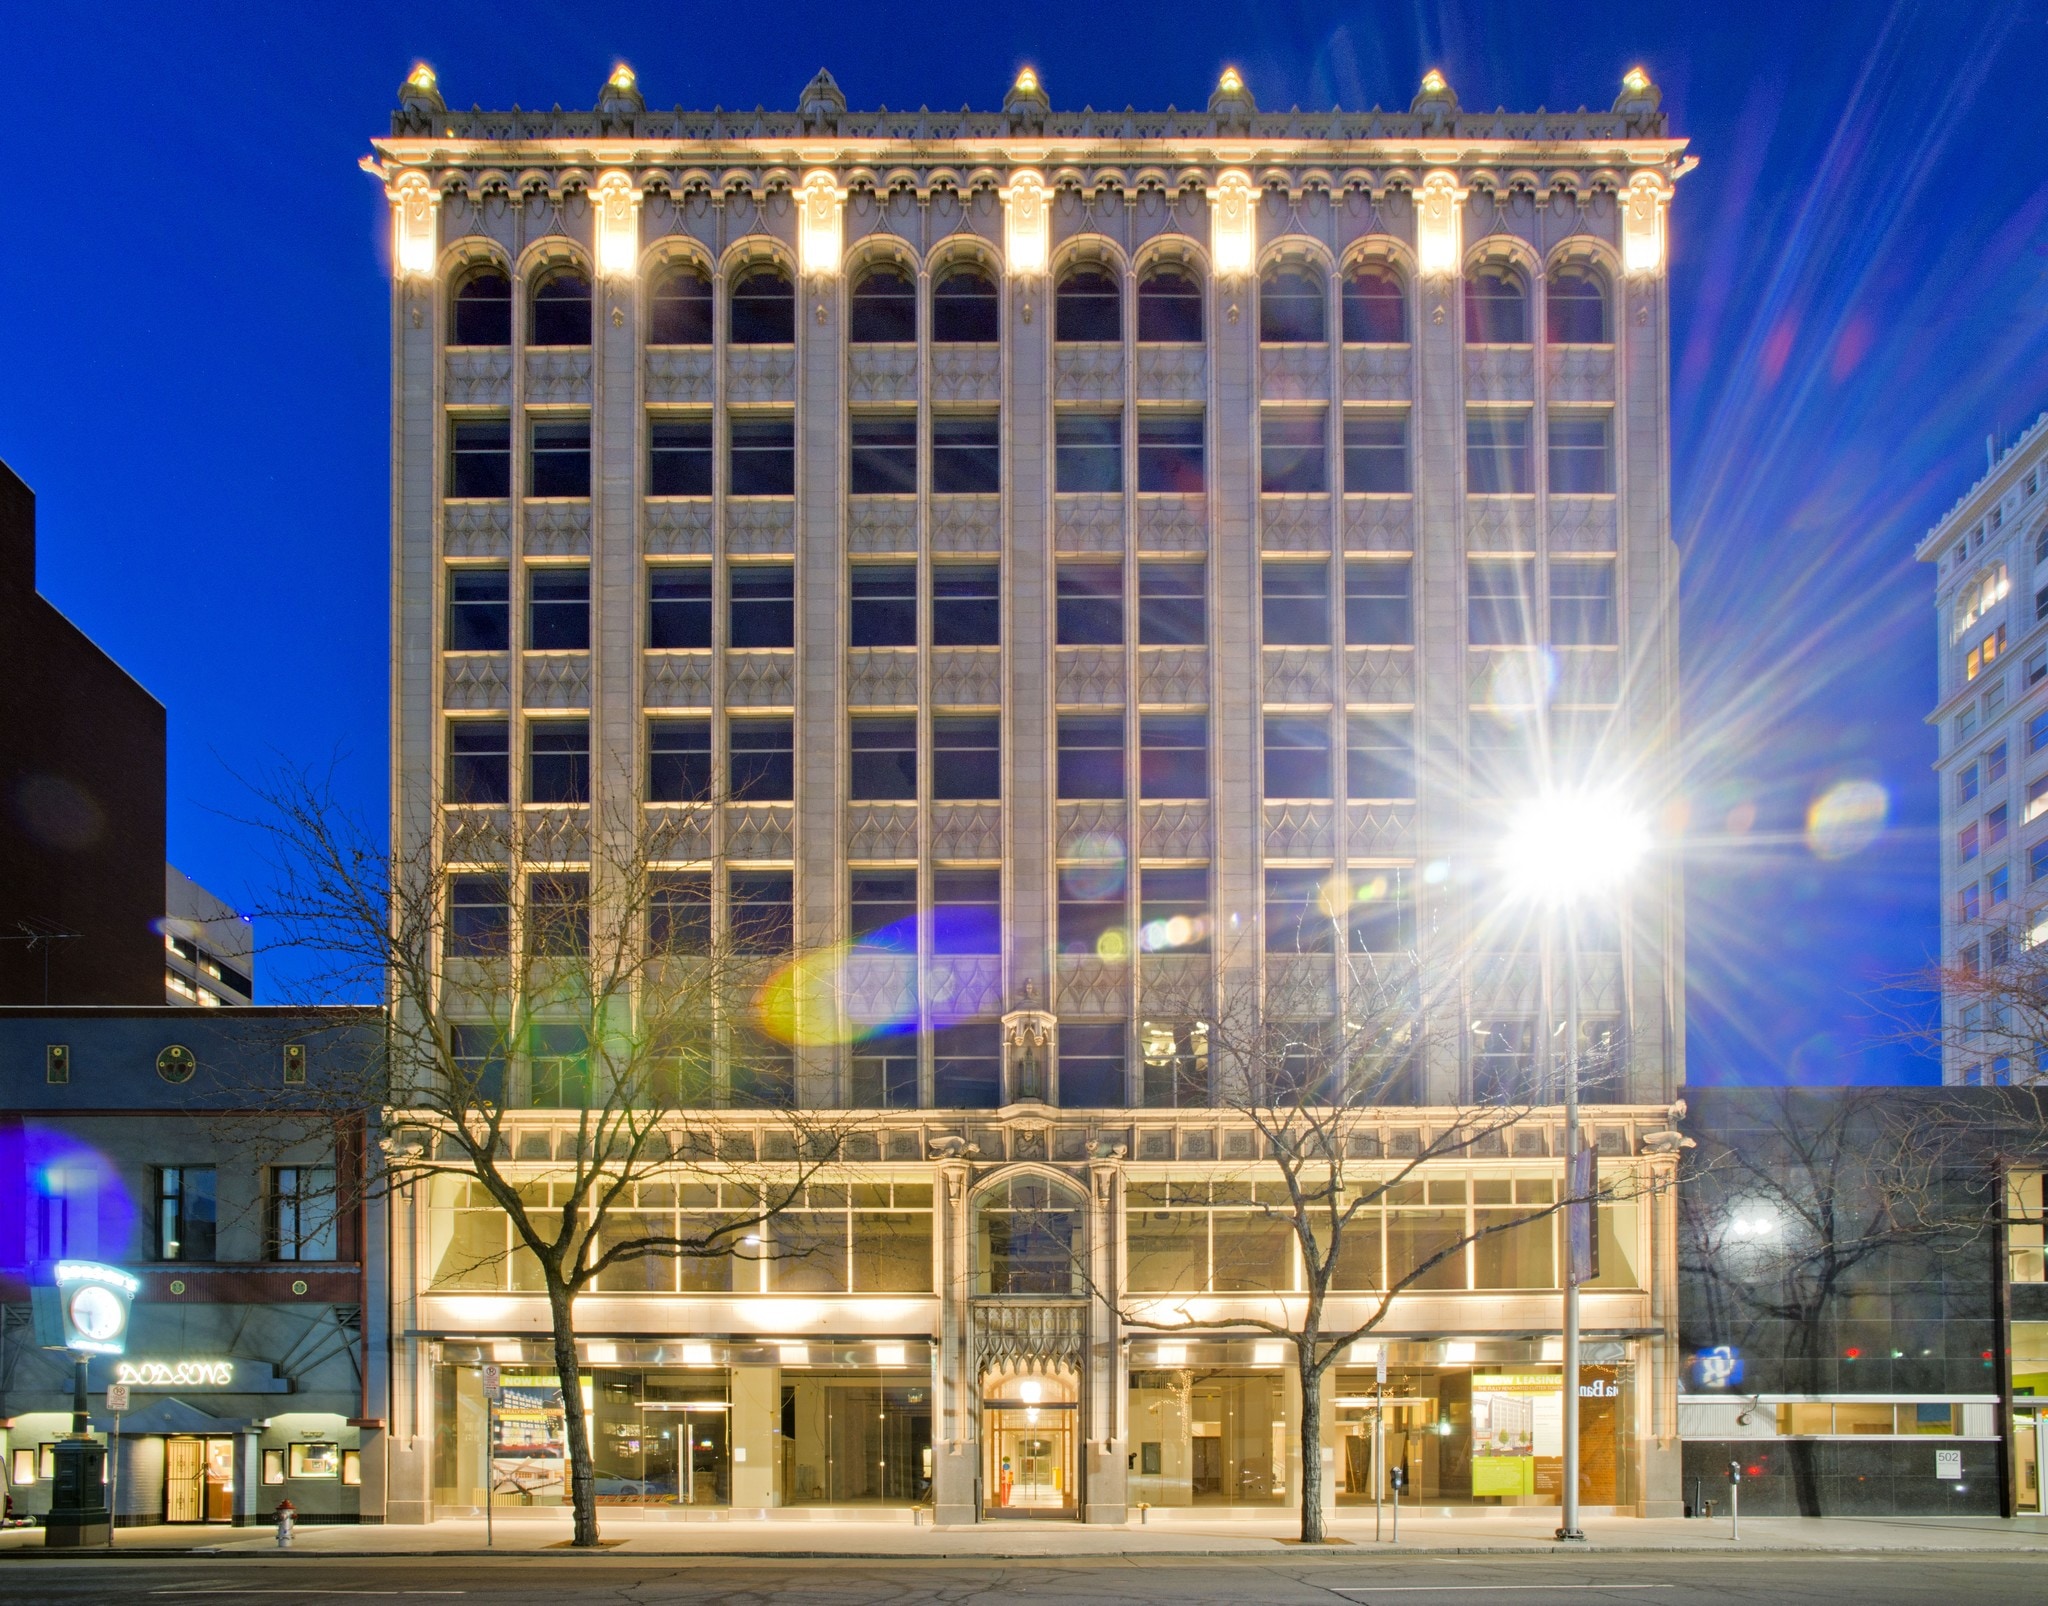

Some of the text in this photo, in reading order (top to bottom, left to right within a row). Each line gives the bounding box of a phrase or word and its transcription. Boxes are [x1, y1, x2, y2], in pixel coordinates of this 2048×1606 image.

[505, 1377, 532, 1386] NOW
[535, 1377, 561, 1386] LEAS
[1485, 1376, 1561, 1385] NOW LEASING
[1938, 1452, 1959, 1461] 502
